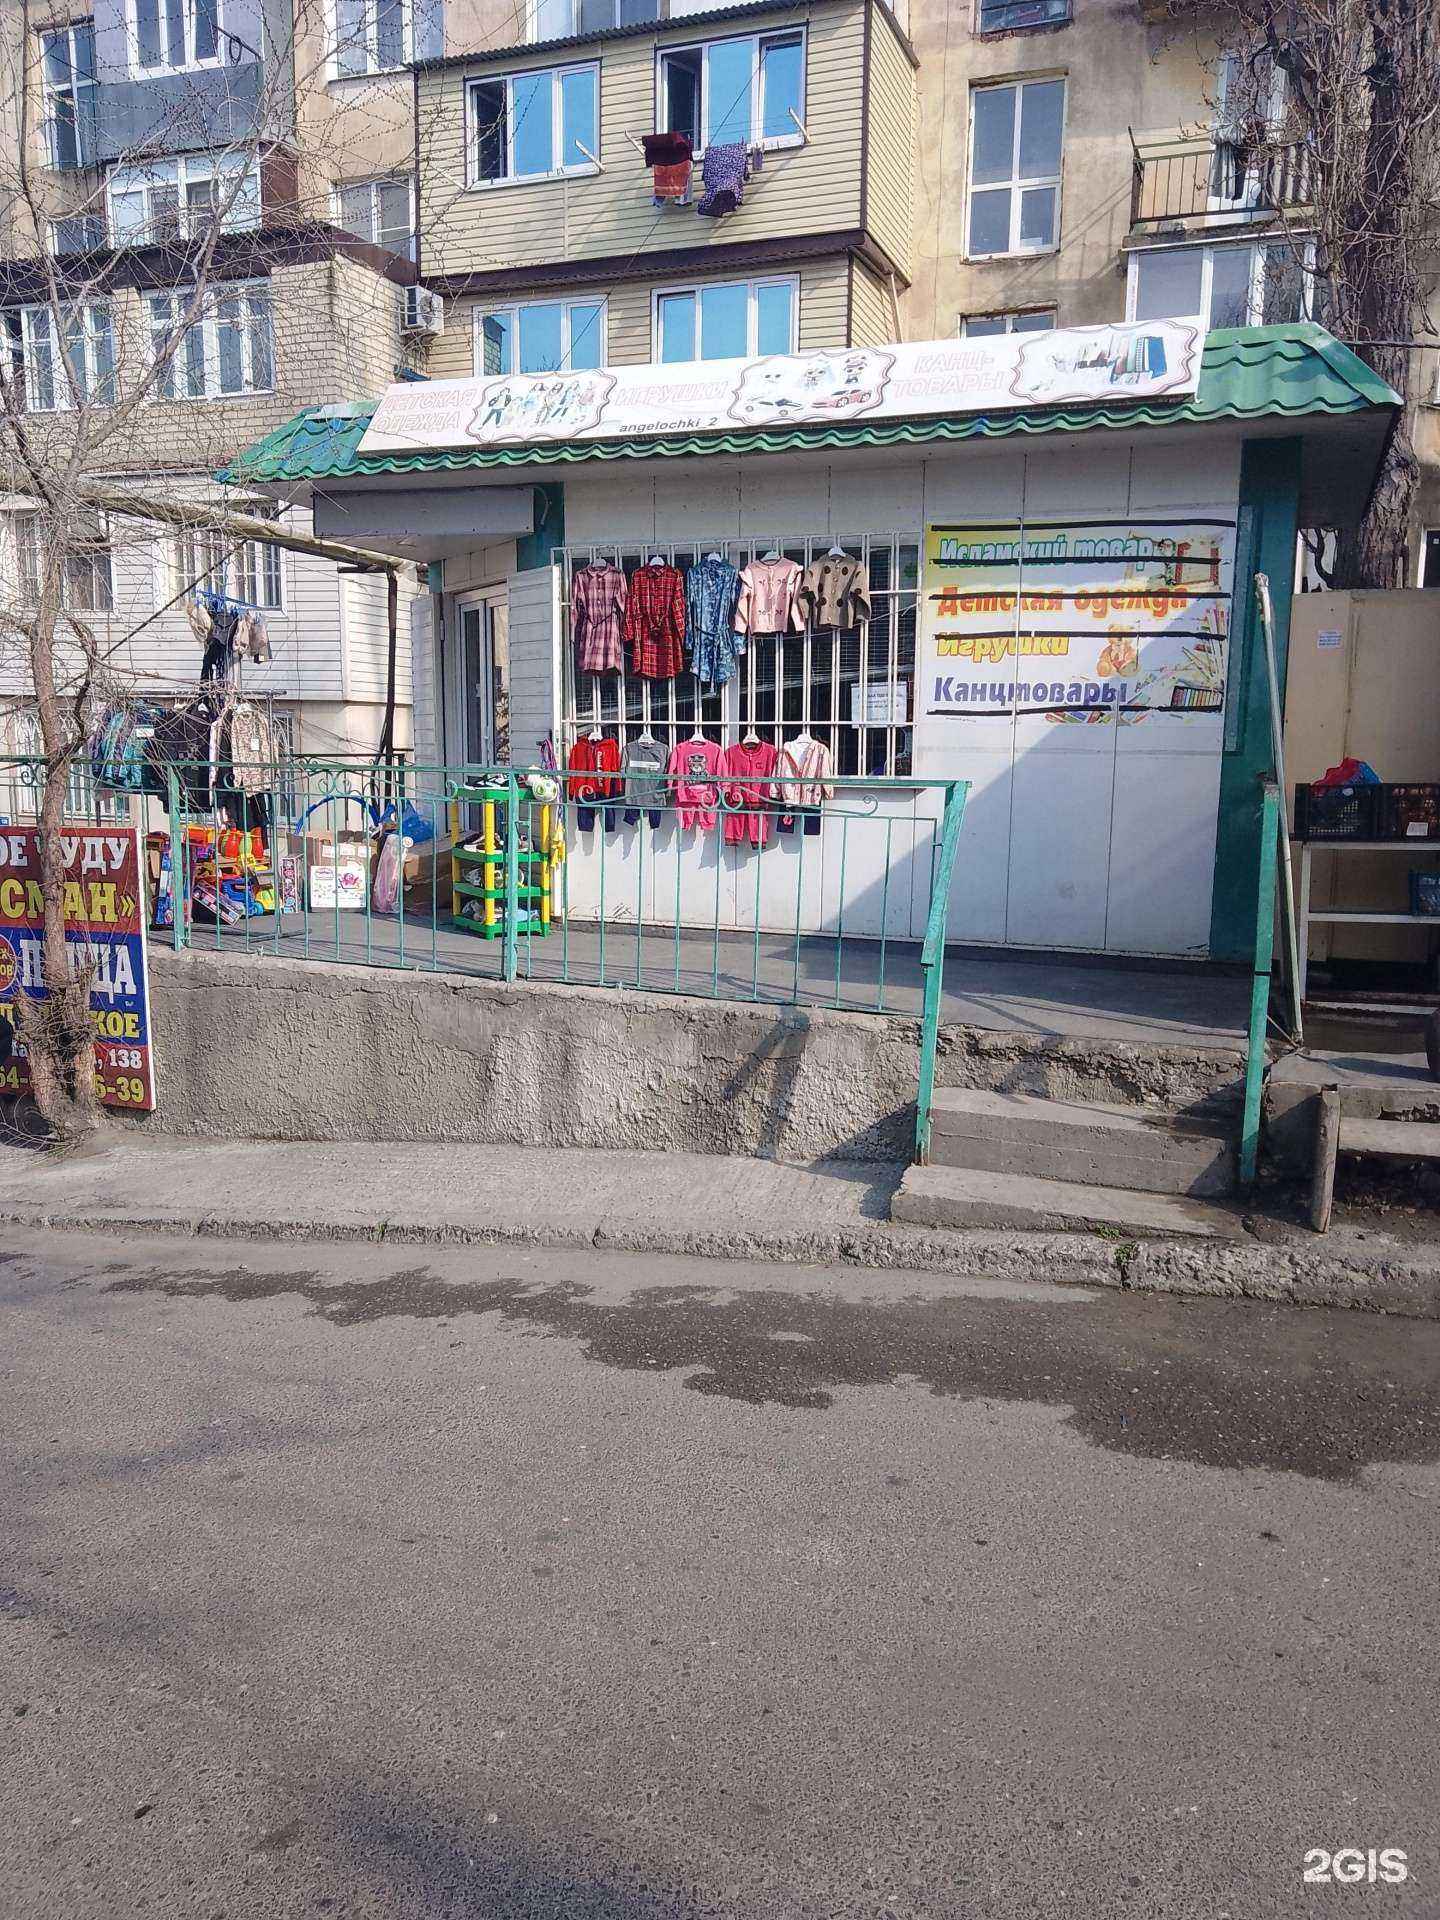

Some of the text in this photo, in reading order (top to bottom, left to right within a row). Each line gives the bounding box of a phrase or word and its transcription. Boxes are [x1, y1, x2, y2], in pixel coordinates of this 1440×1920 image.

[614, 381, 729, 406] ИГРУШКИ
[894, 371, 1005, 398] ТОВАРЫ
[382, 389, 477, 412] ДЕТСКАЯ
[374, 411, 460, 432] ОДЕЖДА
[937, 632, 1069, 663] Игрушки
[934, 677, 1127, 706] Канцтовары
[108, 1049, 142, 1069] 138
